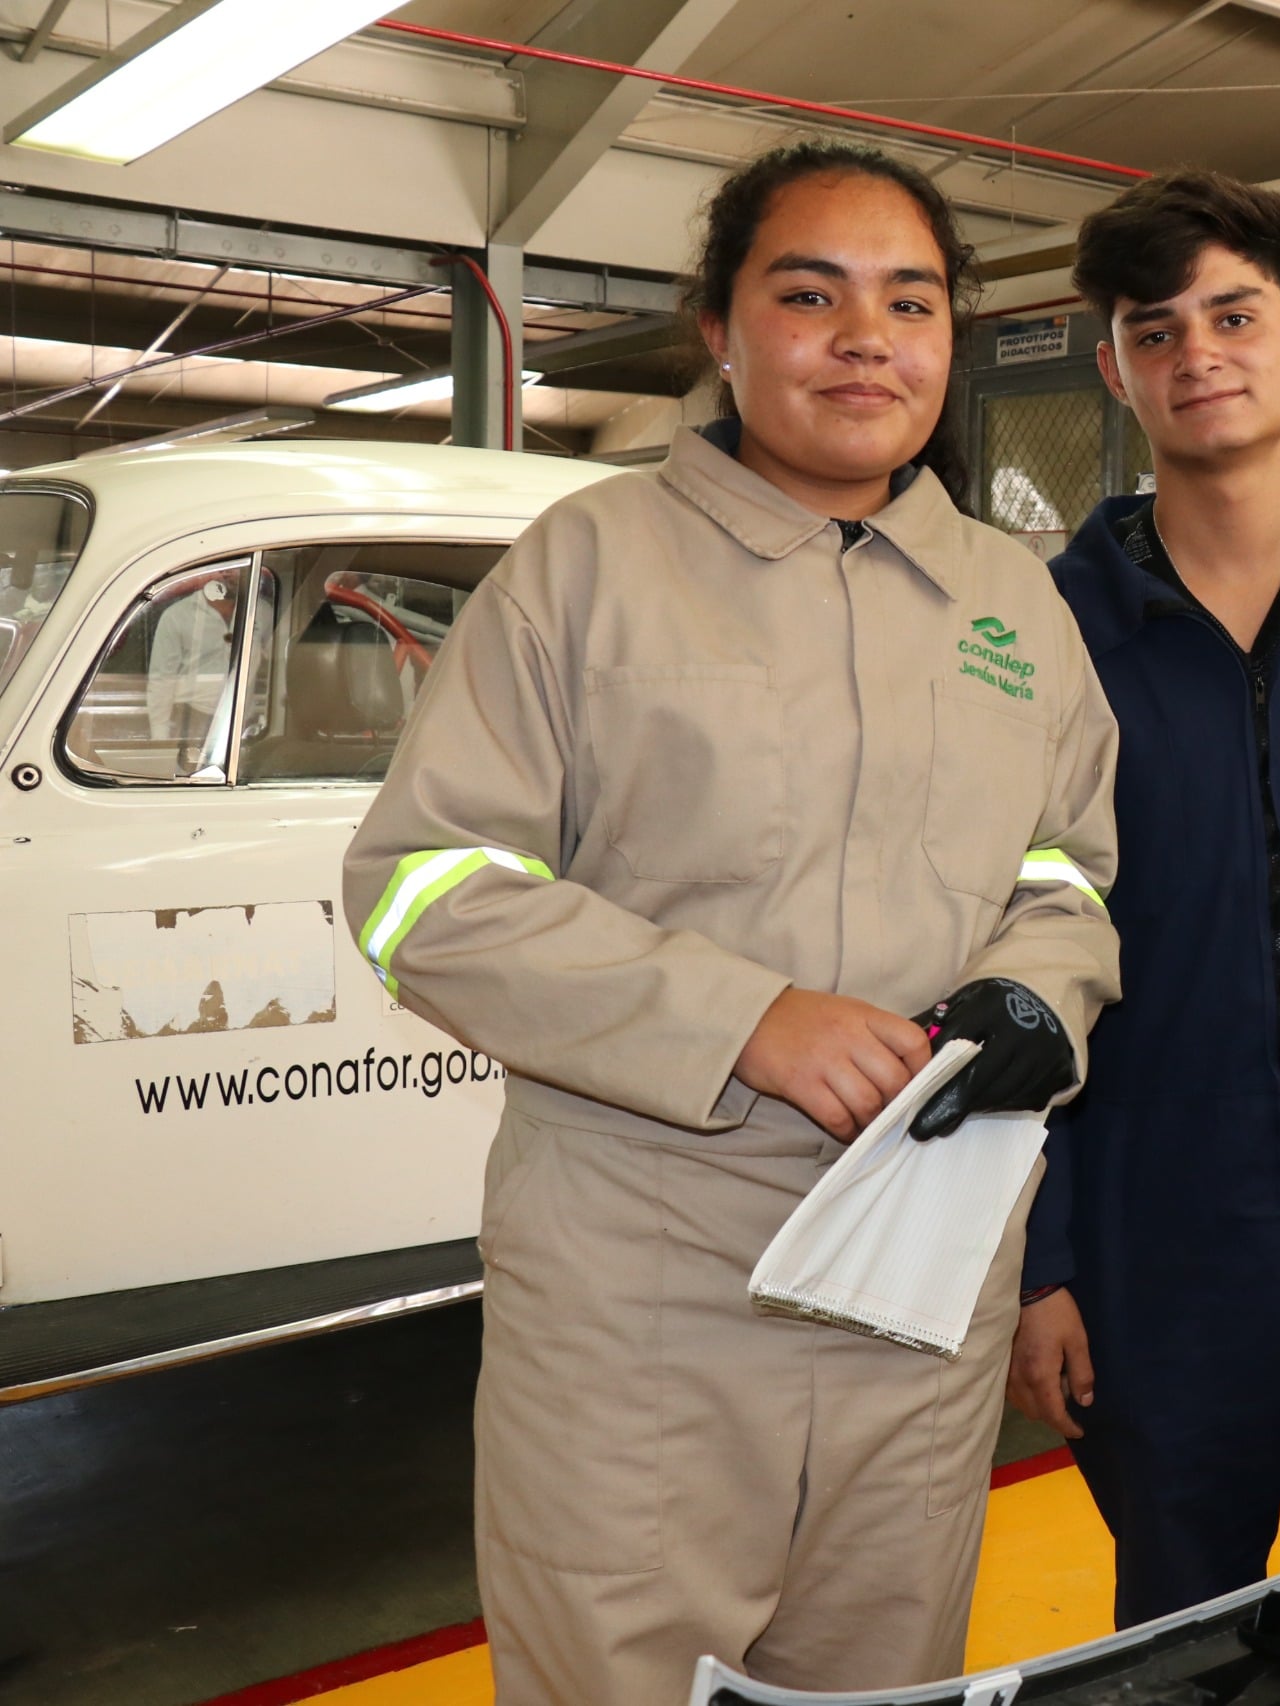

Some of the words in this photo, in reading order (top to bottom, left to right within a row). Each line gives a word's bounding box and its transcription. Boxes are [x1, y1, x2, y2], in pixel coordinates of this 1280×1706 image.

[999, 330, 1064, 347] PROTOTIPOS
[957, 639, 1035, 679] conalep
[959, 661, 997, 686] Jesús
[999, 674, 1034, 700] María
[135, 1046, 507, 1115] www.conafor.gob.
